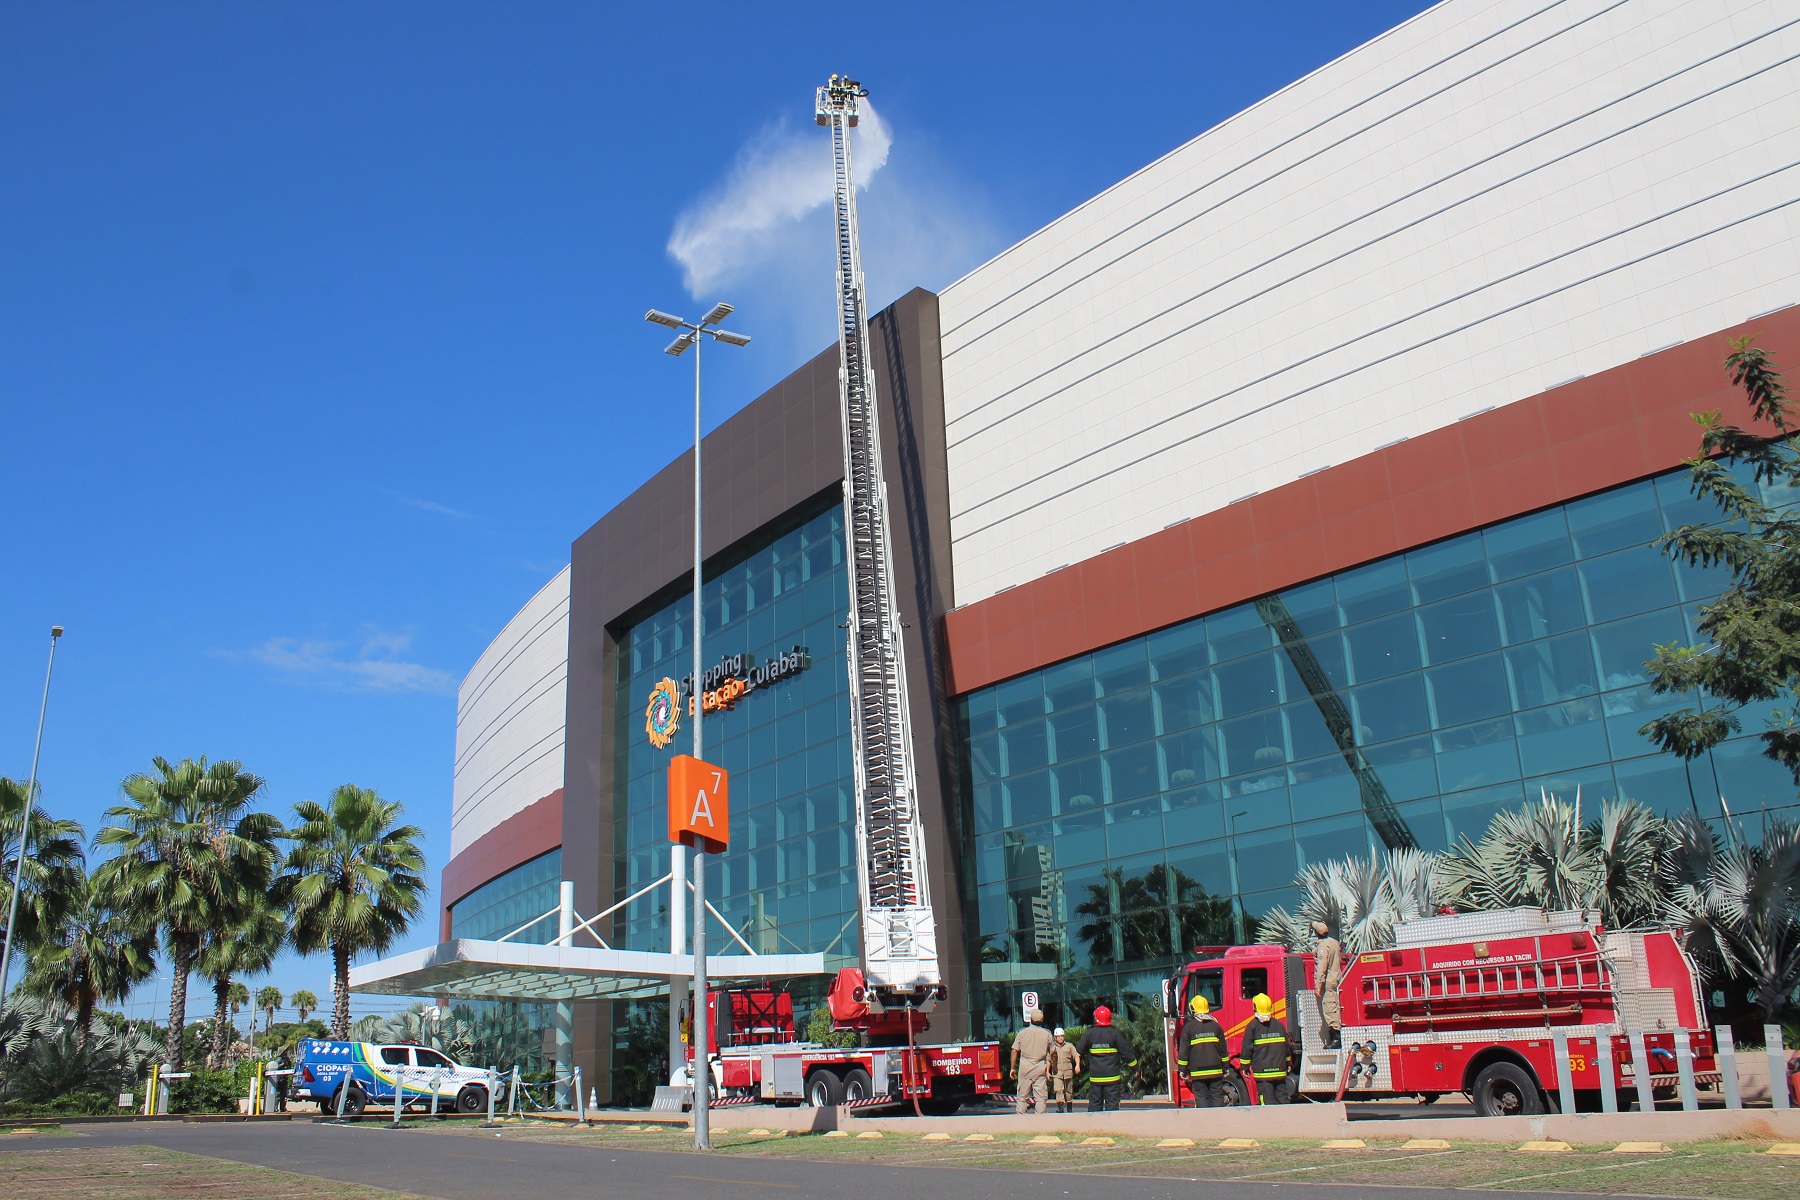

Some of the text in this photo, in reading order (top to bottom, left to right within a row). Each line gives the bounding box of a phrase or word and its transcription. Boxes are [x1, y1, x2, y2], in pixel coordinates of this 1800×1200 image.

[682, 653, 741, 695] Shpping
[689, 645, 804, 716] Etação Cuiabá
[711, 771, 722, 794] 7
[690, 789, 714, 827] A
[1432, 960, 1461, 969] ADQUIRIDO
[1475, 956, 1505, 965] RECURSOS
[1514, 953, 1532, 961] TACIN
[1027, 996, 1032, 1004] E
[932, 1057, 972, 1067] BOMBEIROS
[945, 1065, 960, 1075] 193
[1569, 1058, 1586, 1071] 93
